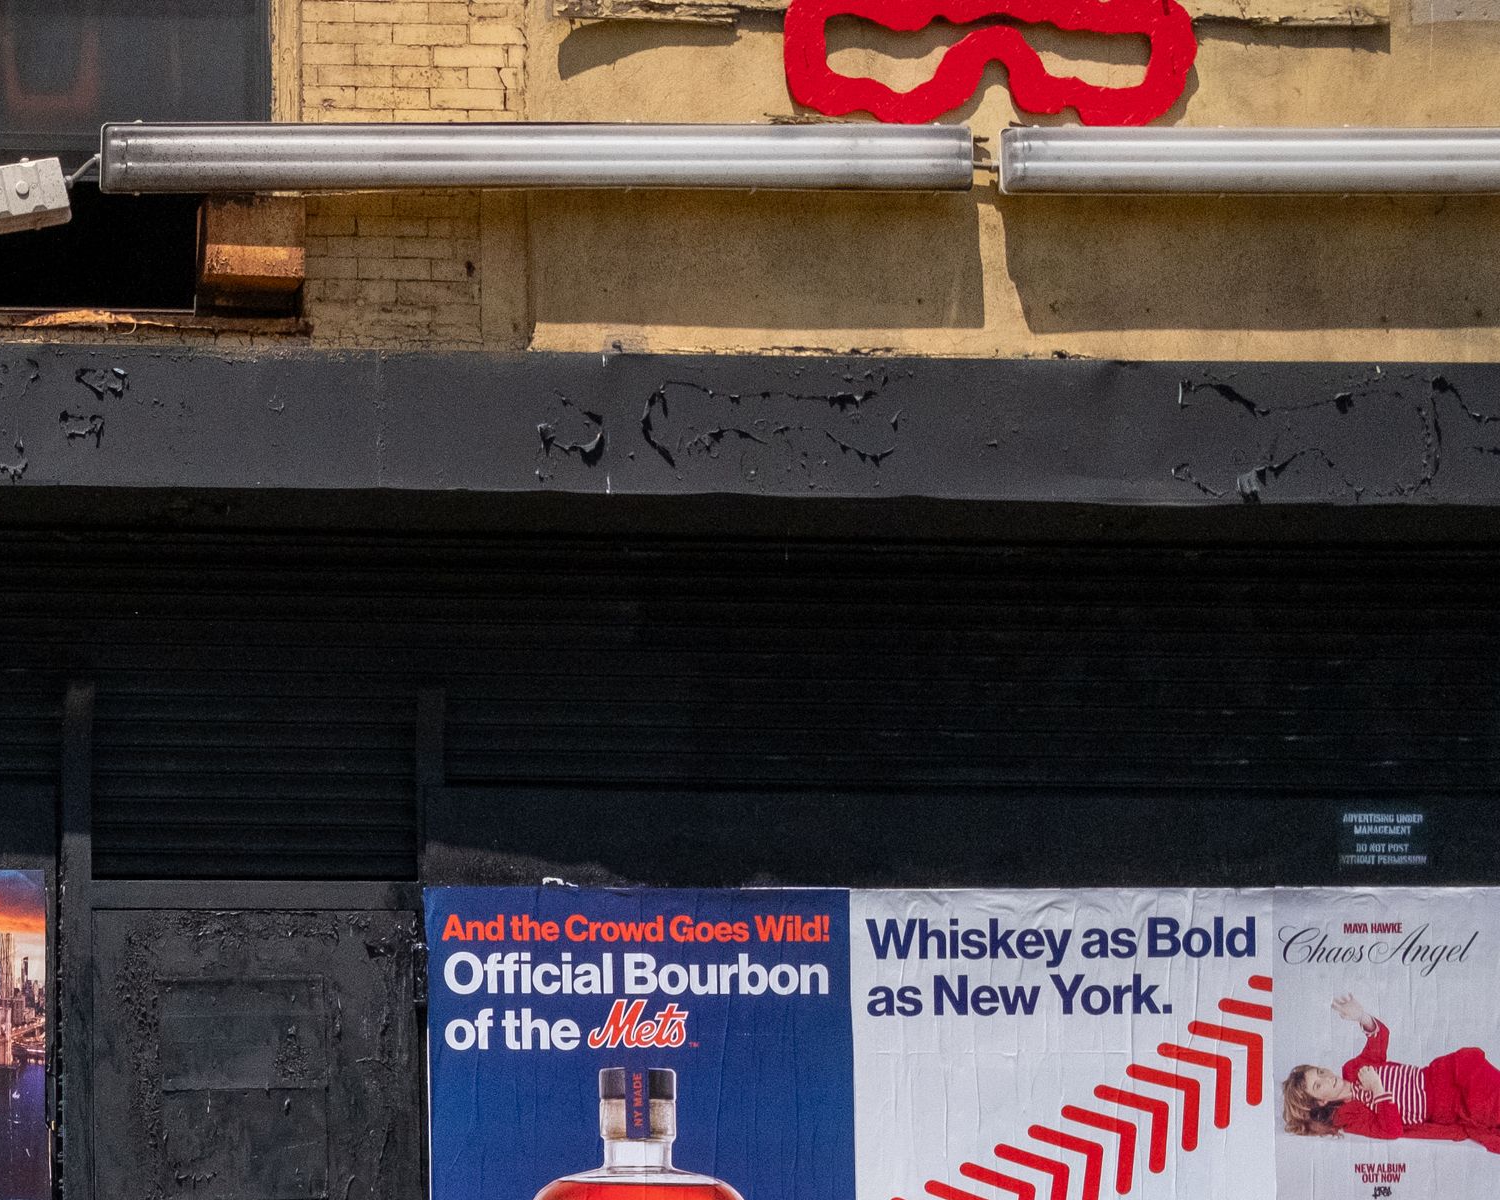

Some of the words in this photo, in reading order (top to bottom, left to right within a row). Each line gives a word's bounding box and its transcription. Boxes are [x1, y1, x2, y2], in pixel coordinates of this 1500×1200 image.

[1342, 813, 1394, 823] ADVERTISING
[1396, 814, 1423, 823] UNDER
[1353, 825, 1411, 835] MANAGEMENT
[1356, 843, 1368, 852] DO
[1369, 843, 1386, 852] NOT
[1388, 843, 1409, 852] POST
[1340, 855, 1375, 865] WITHOUT
[1377, 855, 1427, 864] PERMISSION
[442, 914, 503, 942] And
[510, 914, 560, 942] the
[564, 914, 664, 942] Crowd
[669, 915, 749, 942] Goes
[754, 915, 830, 942] Wild!
[1343, 923, 1369, 934] MAYA
[1371, 922, 1403, 934] HAWKE
[866, 918, 1072, 968] Whiskey
[1081, 927, 1138, 960] as
[1147, 916, 1256, 959] Bold
[1278, 925, 1364, 965] Chaos
[1367, 923, 1479, 977] Angel
[443, 951, 613, 995] Official
[624, 952, 829, 995] Bourbon
[866, 984, 923, 1018] as
[933, 974, 1041, 1017] New
[1049, 973, 1173, 1017] York.
[444, 1008, 493, 1051] of
[502, 1008, 581, 1051] the
[587, 999, 688, 1049] Mets
[632, 1072, 643, 1107] MADE
[632, 1110, 643, 1127] NY
[1354, 1163, 1375, 1173] NEW
[1376, 1163, 1406, 1173] ALBUM
[1362, 1173, 1379, 1183] OUT
[1380, 1173, 1401, 1183] NOW
